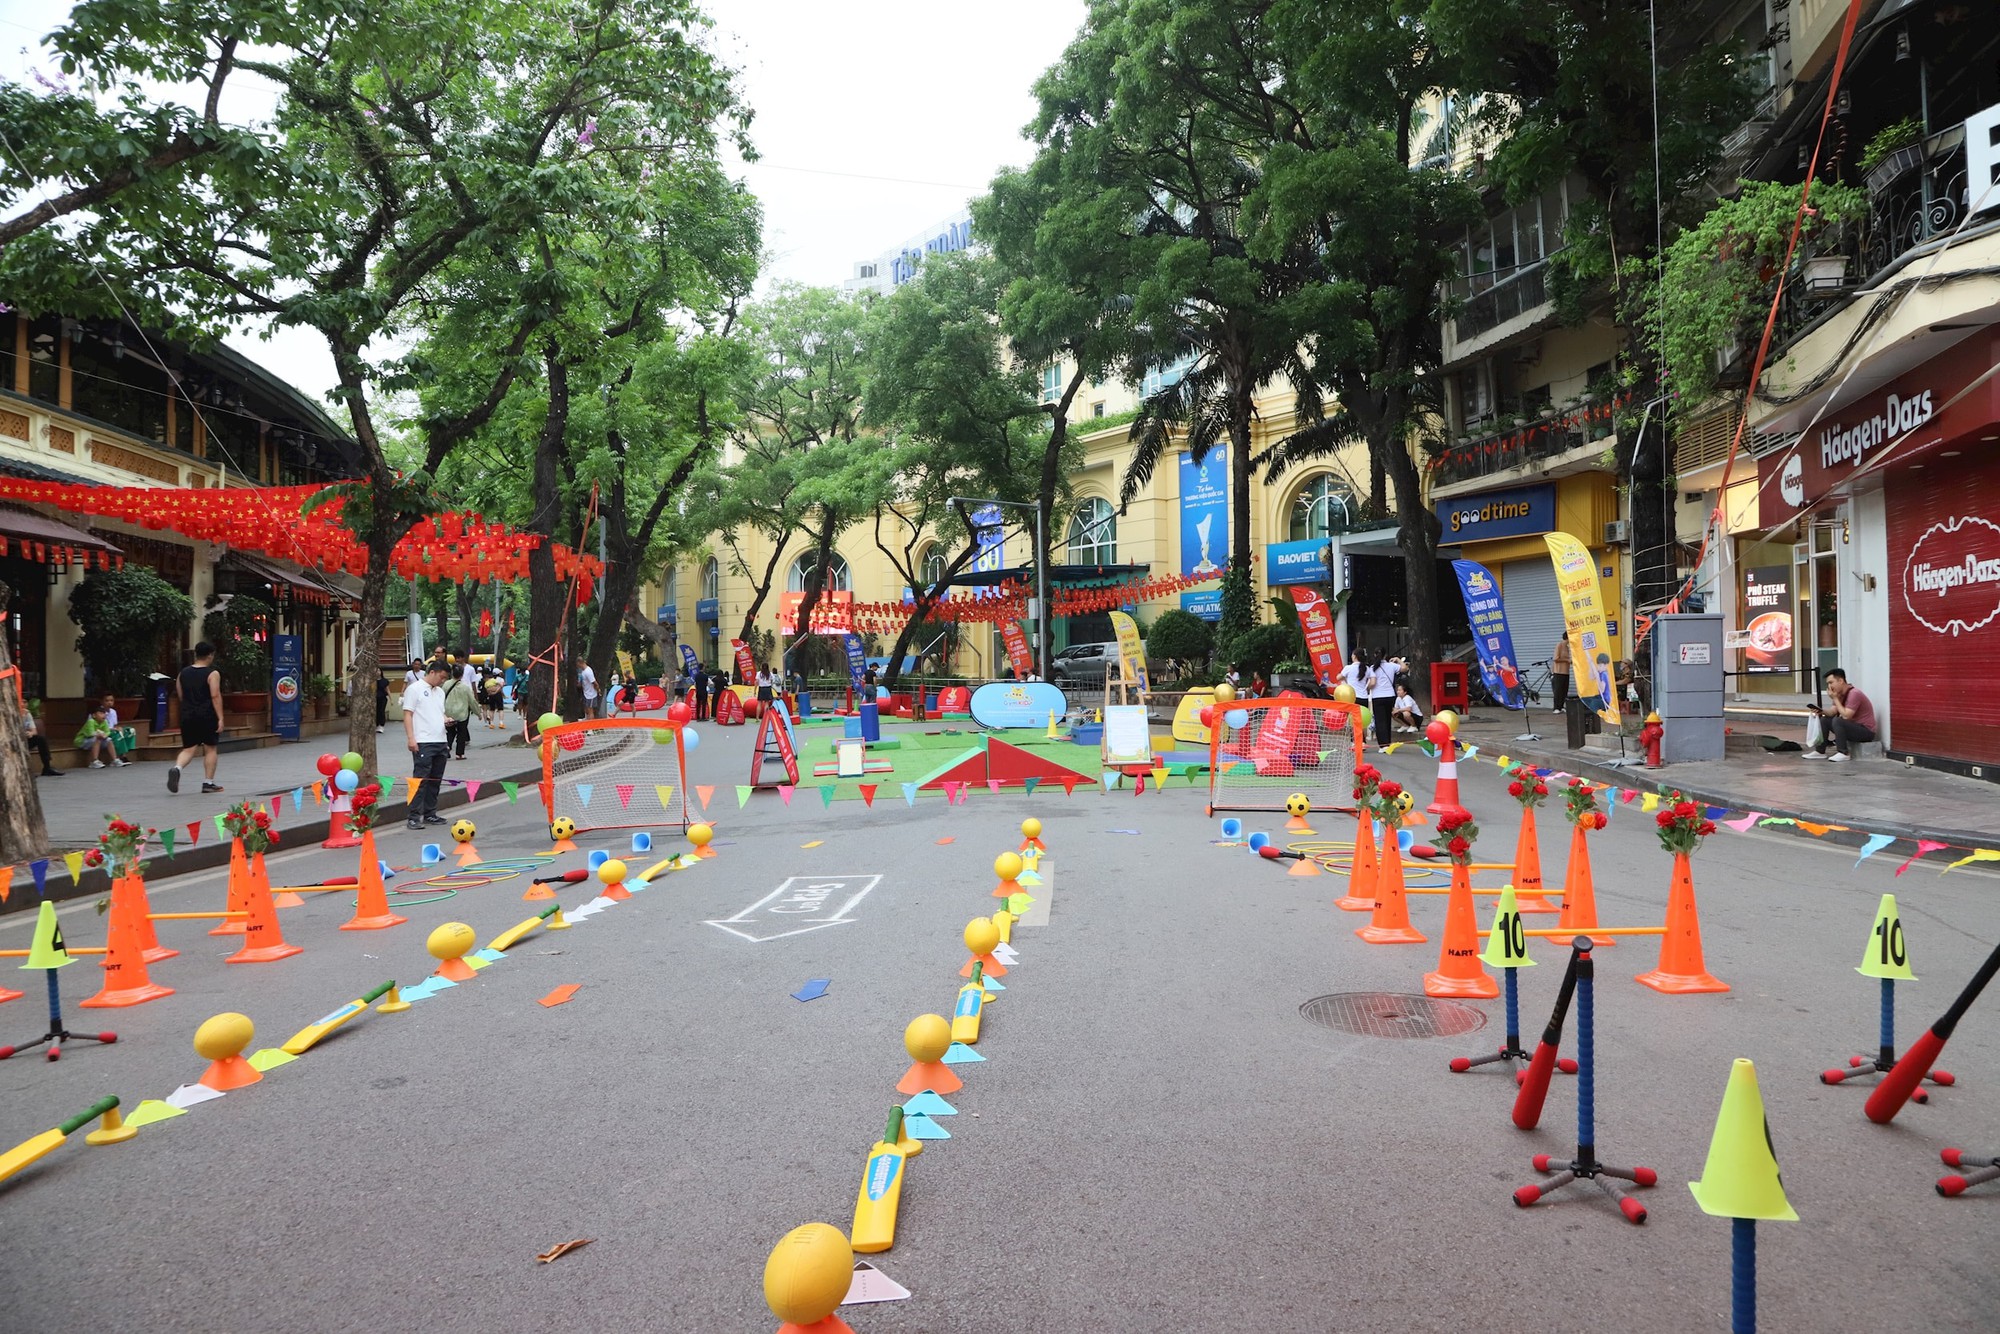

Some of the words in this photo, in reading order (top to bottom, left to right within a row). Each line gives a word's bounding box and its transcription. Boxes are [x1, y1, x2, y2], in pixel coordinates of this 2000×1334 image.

[1821, 389, 1933, 469] Häagen-Dazs
[978, 543, 999, 572] 60
[1763, 584, 1786, 595] STEAK
[1913, 554, 2000, 597] Häagen-Dazs
[1190, 604, 1204, 613] CRM
[1206, 603, 1221, 612] ATM
[1748, 595, 1778, 606] TRUFFLE
[1499, 912, 1525, 958] 10
[1876, 917, 1905, 967] 10
[1448, 949, 1473, 957] HART
